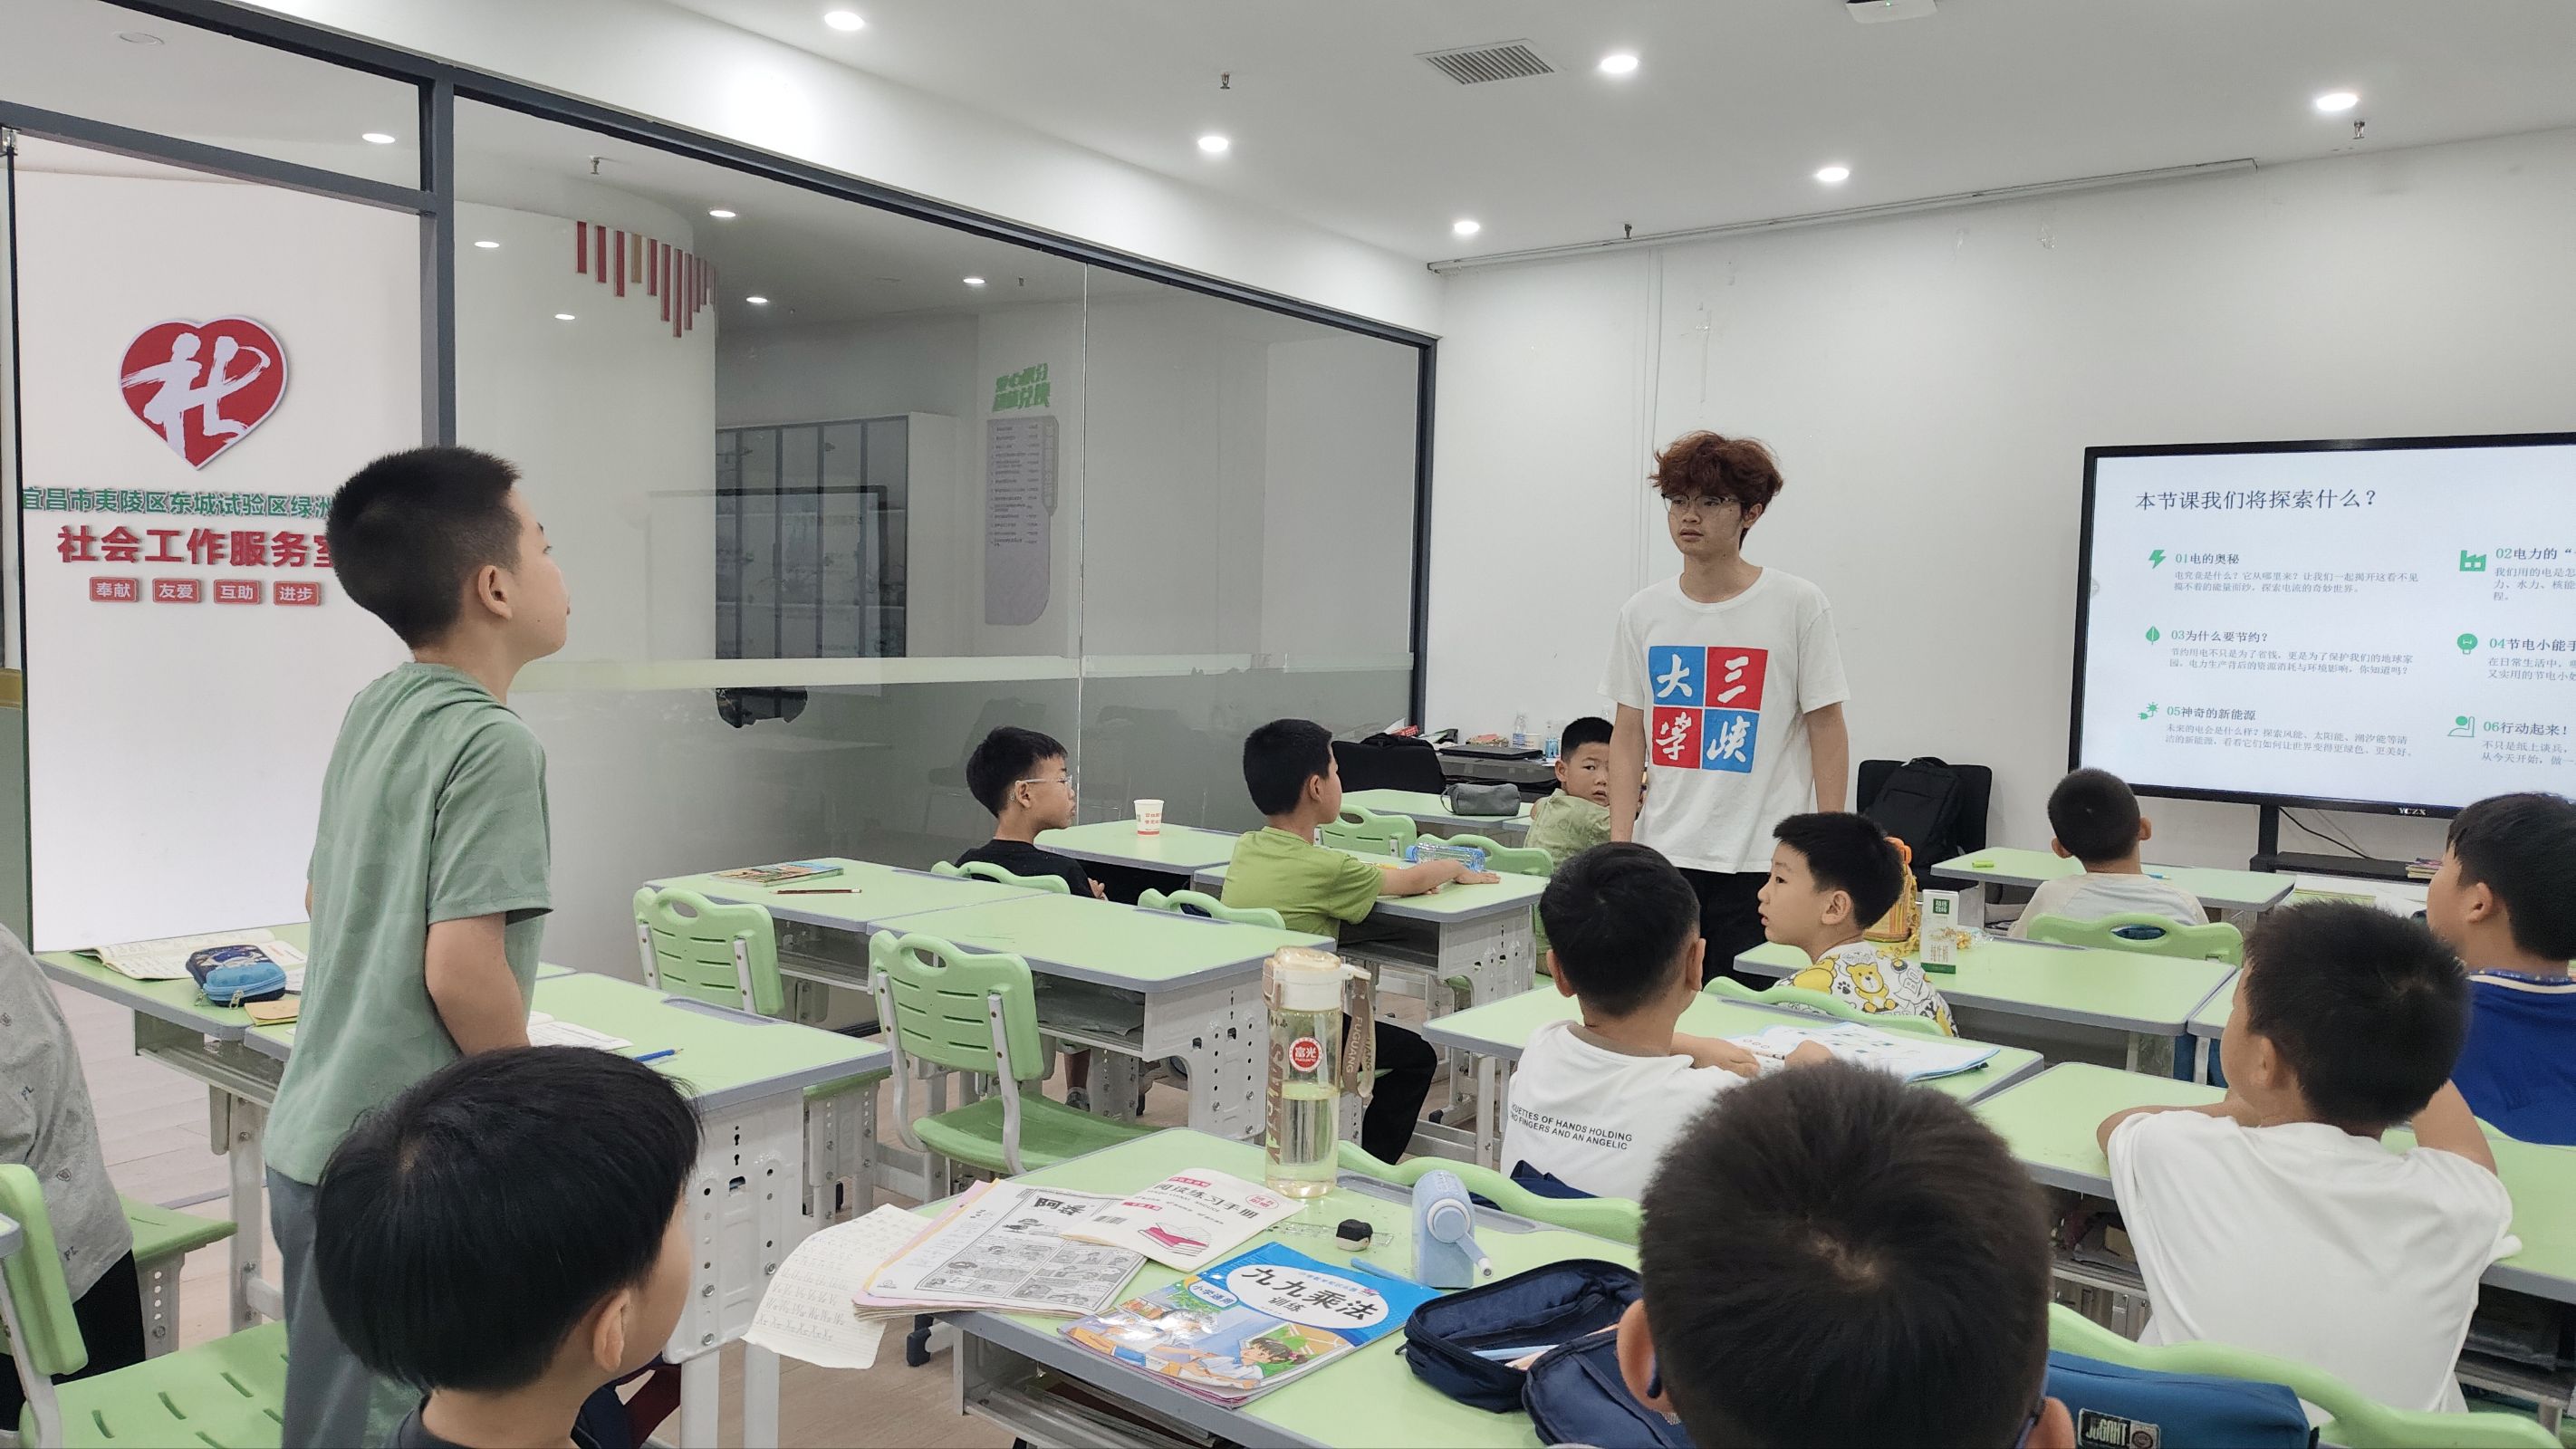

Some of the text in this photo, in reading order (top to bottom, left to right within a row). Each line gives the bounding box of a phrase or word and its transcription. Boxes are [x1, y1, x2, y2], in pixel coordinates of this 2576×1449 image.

[2135, 488, 2376, 510] 本节课我们将探索什么？
[2175, 552, 2240, 565] 01电的奥秘
[2495, 547, 2576, 561] 02电力的“
[95, 581, 313, 603] 奉献 友爱 互助 进步
[2171, 630, 2268, 643] 03为什么要节约？
[2167, 705, 2256, 722] 05神奇的新能源
[2483, 721, 2567, 736] 06行动起来！
[2482, 752, 2576, 766] 从今天开始，做一
[1295, 1047, 1317, 1059] 富光
[1346, 1016, 1363, 1074] FUGUANG
[1519, 1115, 1550, 1134] FINGERS
[1552, 1128, 1571, 1139] AND
[1572, 1132, 1584, 1142] AN
[1586, 1136, 1629, 1151] ANGELIC
[1542, 1115, 1554, 1125] OF
[1556, 1118, 1587, 1134] HANDS
[1589, 1127, 1633, 1143] HOLDING
[1153, 1183, 1260, 1220] 阅读练习手册
[1241, 1268, 1379, 1320] 九九乘法
[1268, 1296, 1306, 1312] 训练
